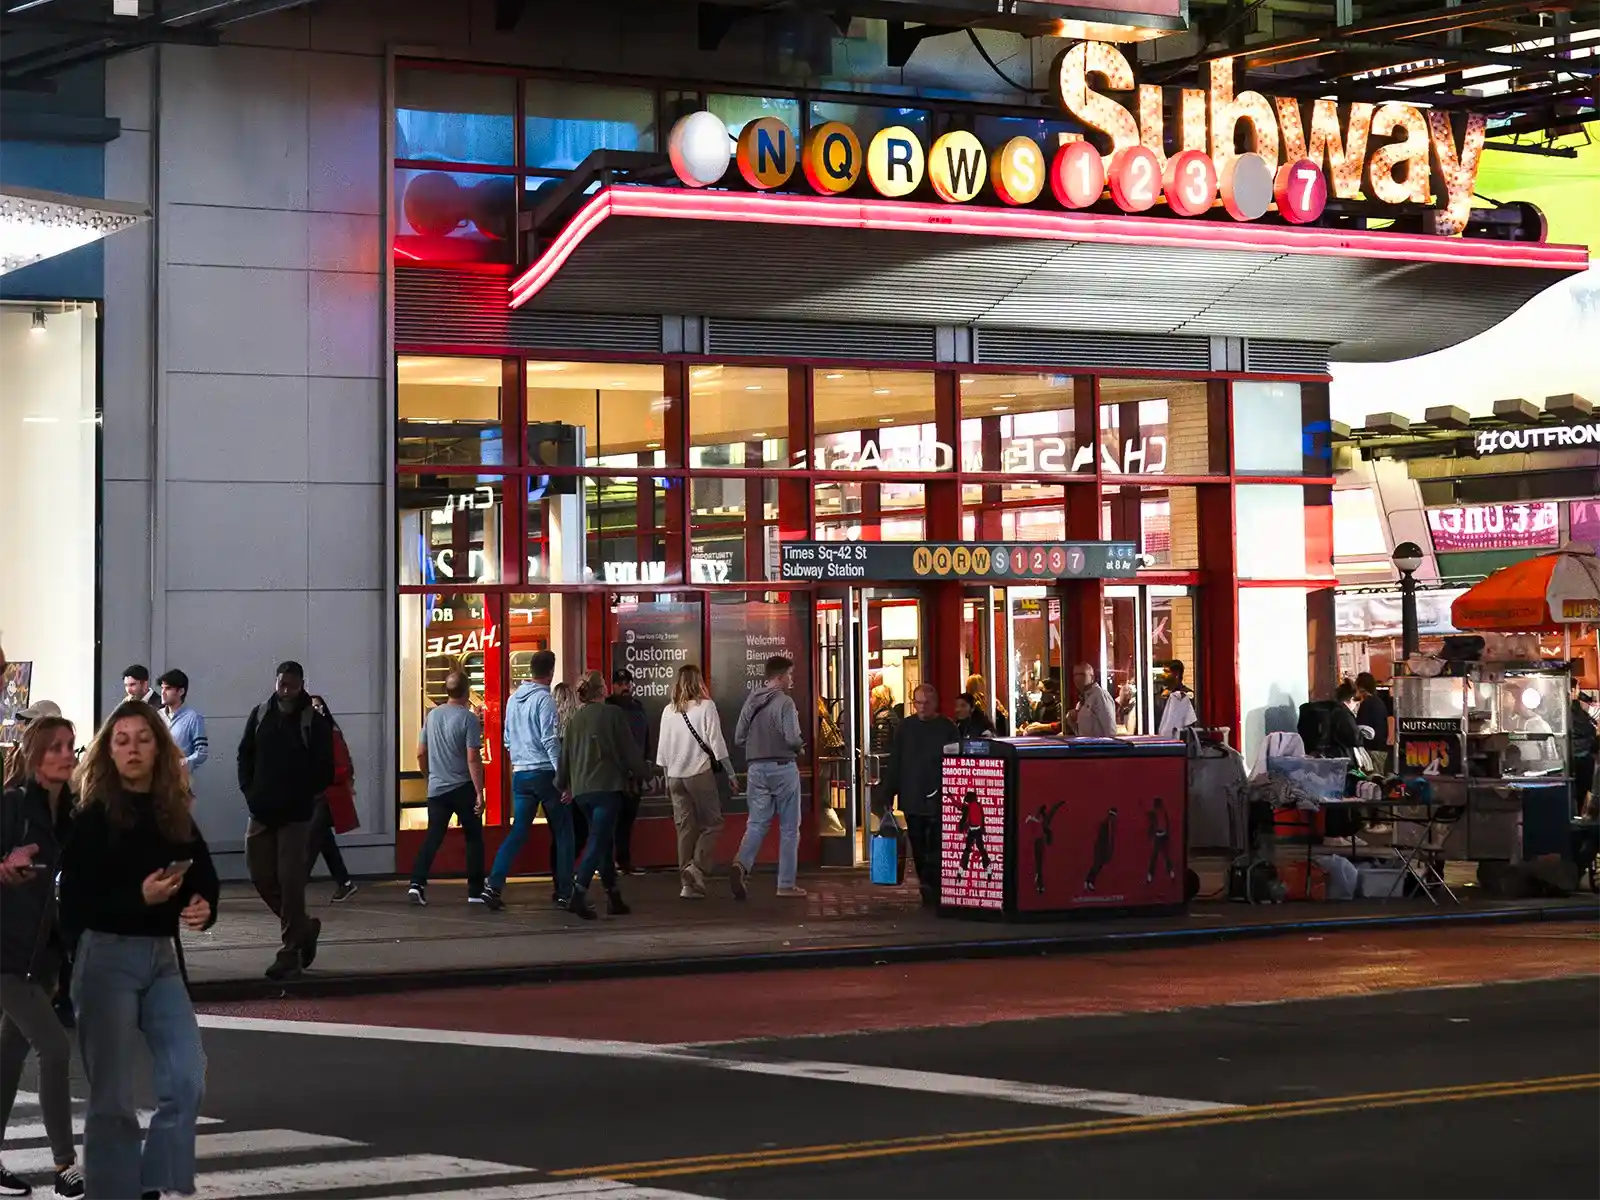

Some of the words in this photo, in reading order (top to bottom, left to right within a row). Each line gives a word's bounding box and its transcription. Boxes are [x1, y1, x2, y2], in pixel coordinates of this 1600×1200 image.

[1058, 41, 1487, 236] Subway
[757, 128, 787, 174] N
[823, 131, 853, 181] Q
[887, 137, 913, 183] R
[945, 146, 982, 195] W
[1010, 146, 1036, 192] S
[1074, 151, 1090, 196] 1
[1129, 156, 1153, 201] 2
[1186, 159, 1208, 205] 3
[1296, 169, 1318, 211] 7
[782, 545, 815, 560] Times
[818, 545, 852, 561] Sq-42
[855, 545, 868, 560] St
[917, 553, 928, 569] N
[937, 553, 948, 570] Q
[956, 553, 967, 568] R
[974, 553, 988, 569] W
[995, 552, 1005, 569] S
[1015, 553, 1022, 569] 1
[1034, 553, 1042, 569] 2
[1052, 552, 1061, 568] 3
[1071, 553, 1080, 568] 7
[782, 563, 824, 579] Subway
[827, 563, 865, 577] Station
[746, 635, 786, 646] Welcome
[625, 645, 688, 662] Customer
[626, 663, 674, 679] Service
[1405, 740, 1449, 768] NUTS
[941, 758, 957, 766] JAM
[960, 758, 976, 767] BAD
[978, 759, 1004, 768] MONEY
[942, 768, 971, 776] SMOOTH
[941, 851, 963, 860] BEAT
